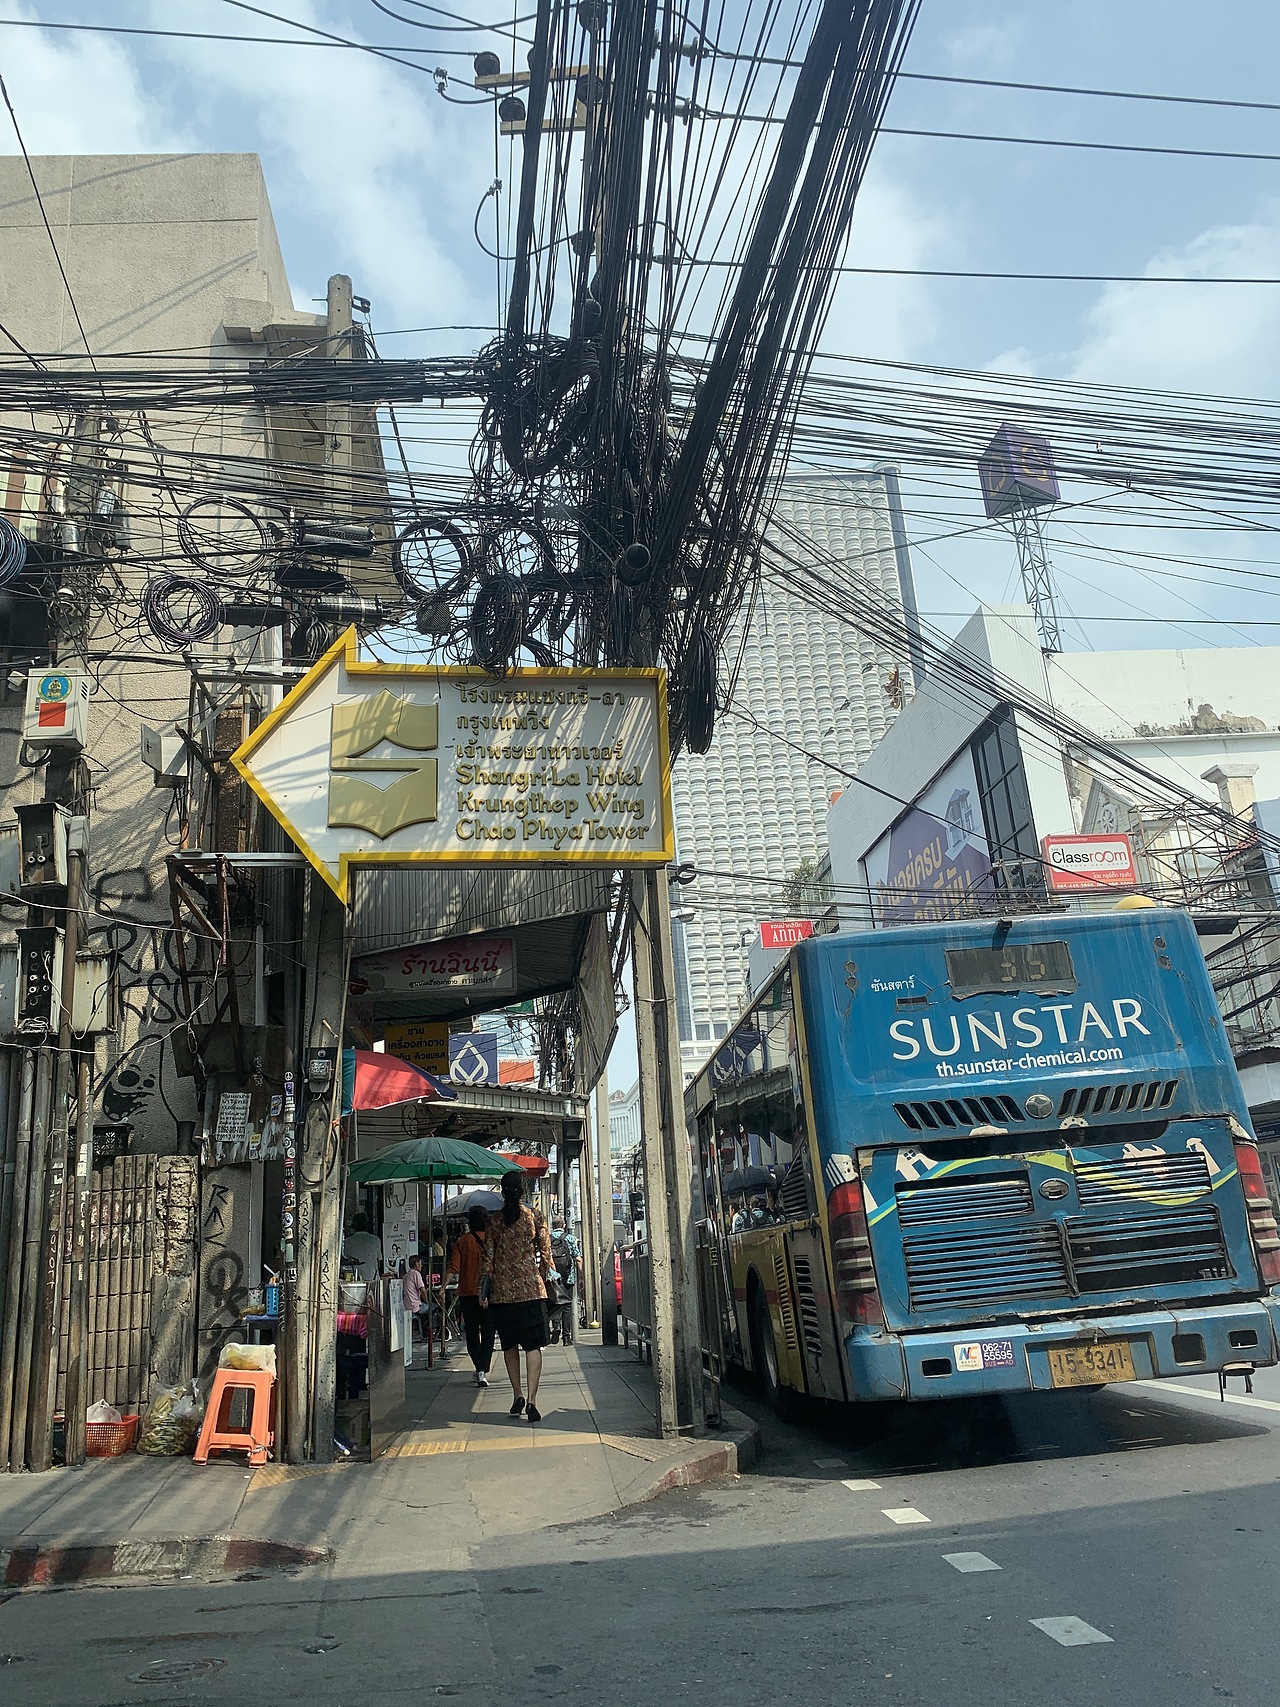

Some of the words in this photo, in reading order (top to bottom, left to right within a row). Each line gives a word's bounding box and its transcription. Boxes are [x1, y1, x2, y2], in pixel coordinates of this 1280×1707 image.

[456, 710, 550, 735] กรุงเทพวิง
[456, 738, 625, 761] เจ้าพระยาทาวเวอร์
[586, 764, 643, 786] Hotel
[457, 791, 579, 819] Krungthep
[586, 792, 645, 820] Wing
[456, 818, 517, 841] Chao
[583, 818, 650, 840] Tower
[1052, 848, 1127, 864] Classroom
[871, 974, 915, 992] ซันสตาร์
[889, 998, 1152, 1061] SUNSTAR
[388, 1036, 445, 1050] เครื่องสำอาง
[936, 1045, 1124, 1078] th.sunstar-chemical.com
[982, 1341, 1012, 1353] 062-71
[983, 1350, 1013, 1362] 55595
